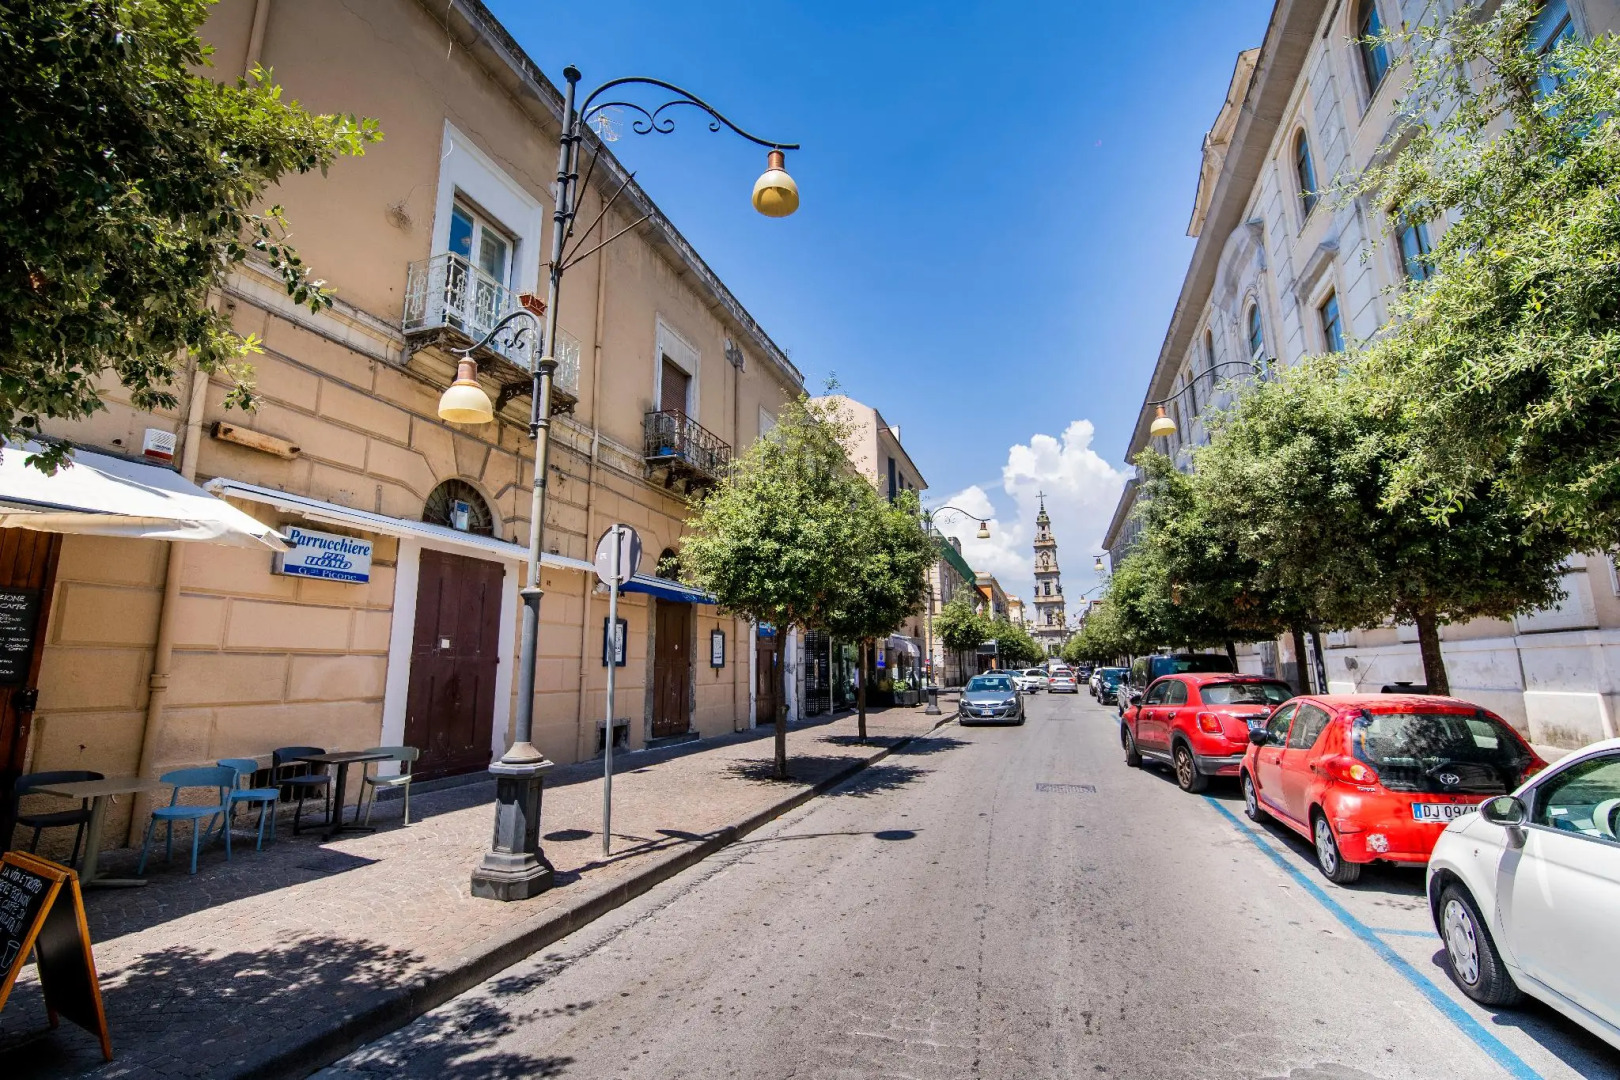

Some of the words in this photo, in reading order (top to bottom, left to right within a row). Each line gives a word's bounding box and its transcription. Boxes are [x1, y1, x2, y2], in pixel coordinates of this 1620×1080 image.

[290, 529, 370, 556] Parrucchiere
[305, 556, 352, 569] UOMO
[322, 552, 345, 560] PER
[322, 570, 356, 580] Picone
[1423, 805, 1440, 818] DJ
